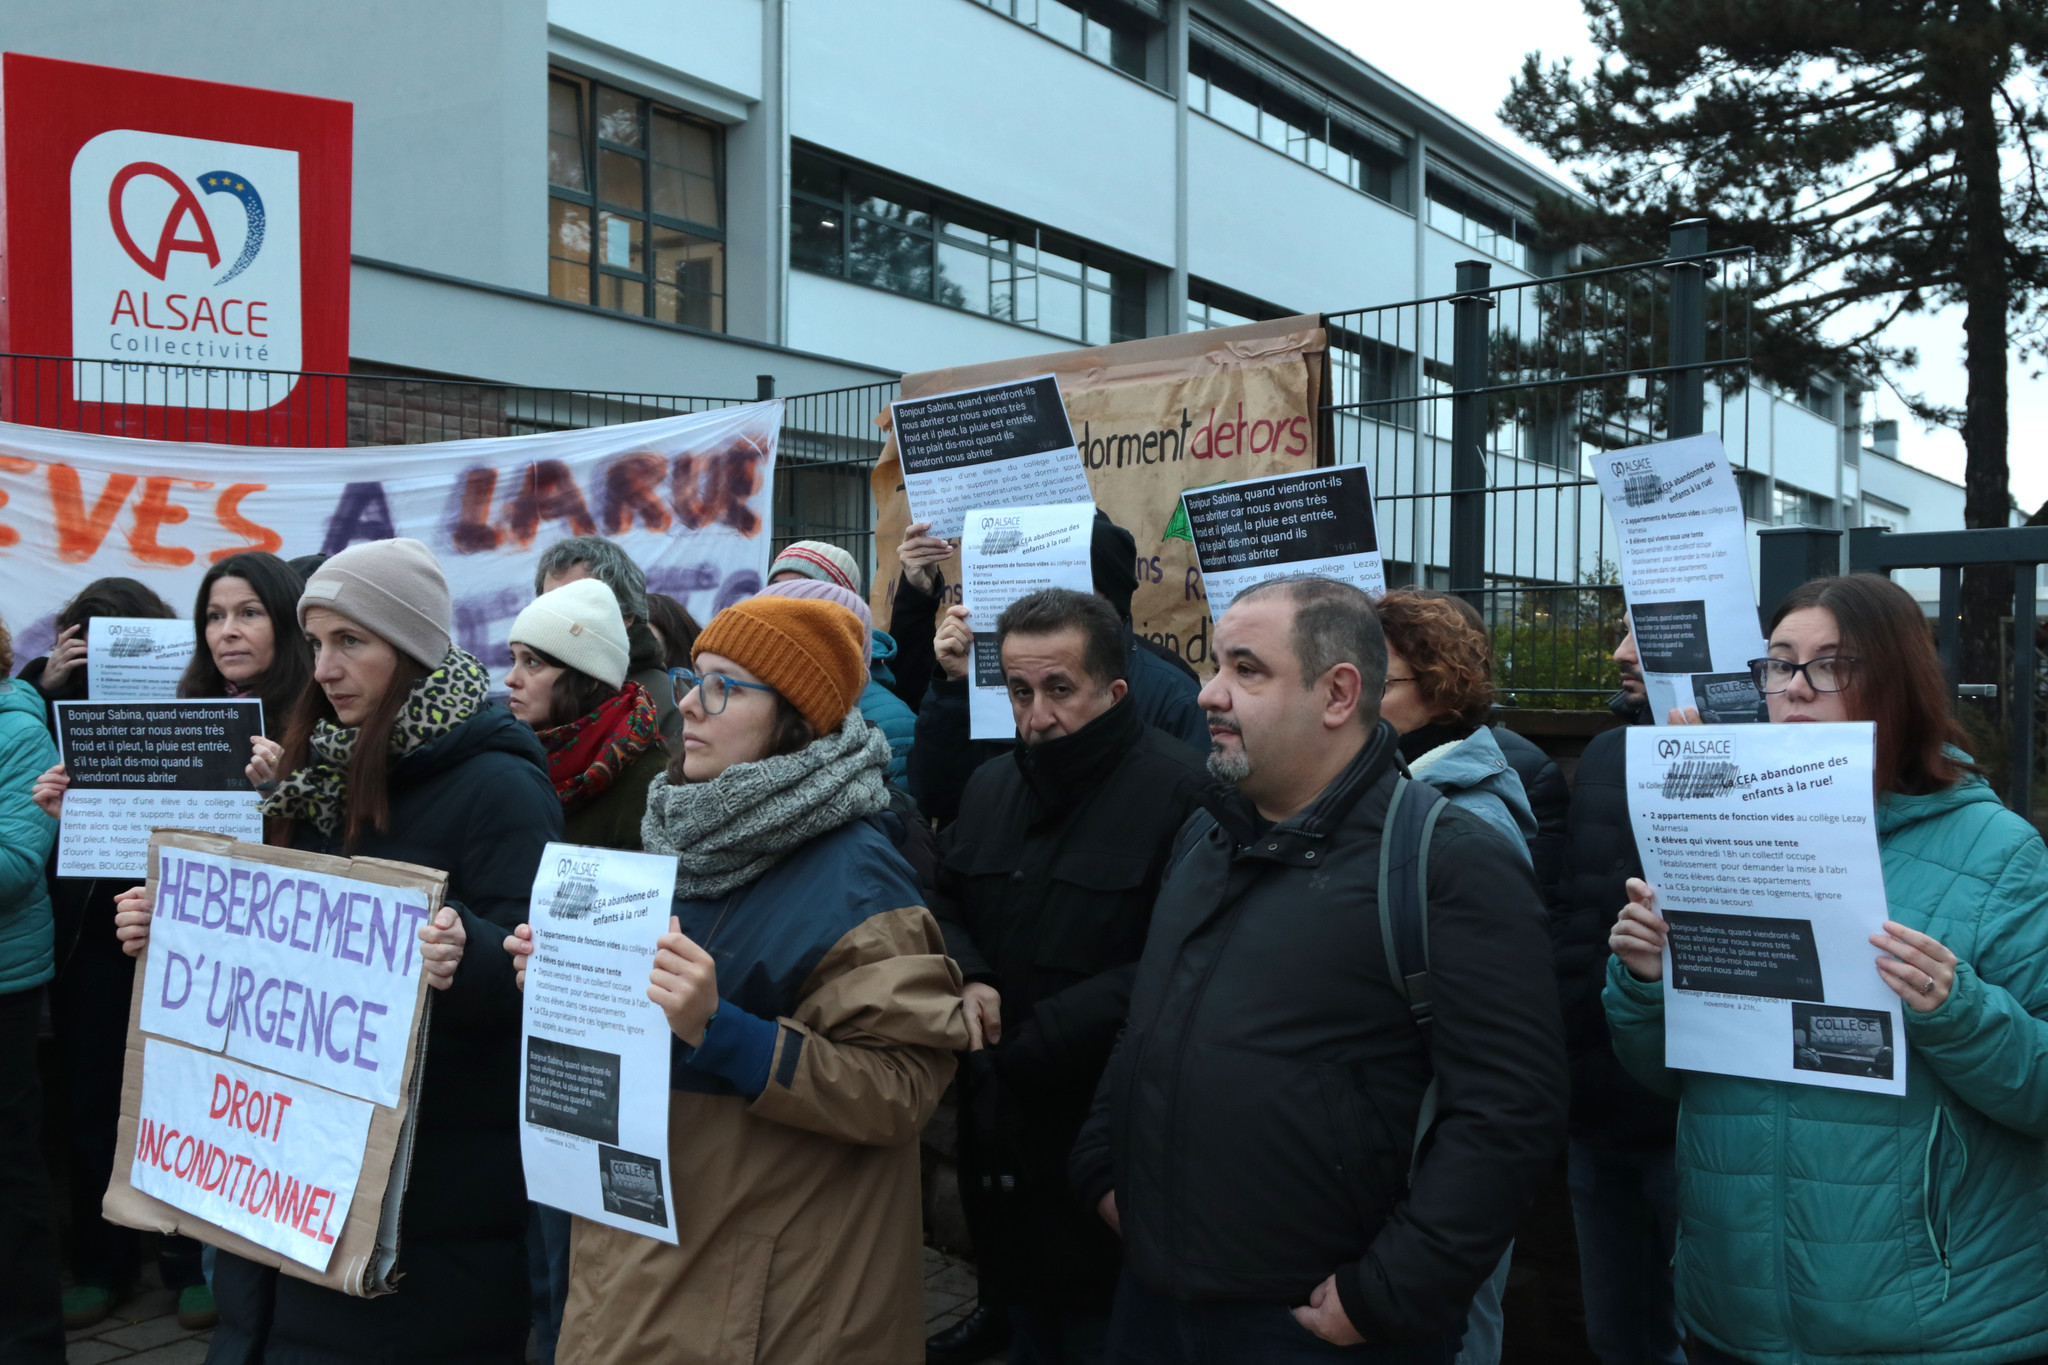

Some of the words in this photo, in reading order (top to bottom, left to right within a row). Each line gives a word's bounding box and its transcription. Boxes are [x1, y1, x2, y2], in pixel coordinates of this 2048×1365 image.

[110, 289, 268, 337] ALSACE
[110, 333, 268, 361] Collectivité
[900, 408, 925, 417] Bonjour
[927, 403, 956, 413] Sabina,
[957, 396, 982, 409] quand
[984, 387, 1035, 403] viendront-ils
[902, 421, 919, 430] nous
[920, 417, 944, 427] abriter
[946, 415, 958, 423] car
[960, 411, 980, 421] nous
[982, 406, 1007, 417] avons
[1009, 402, 1026, 412] très
[904, 432, 920, 442] froid
[922, 432, 929, 440] et
[930, 430, 936, 438] il
[937, 425, 960, 440] pleut,
[959, 425, 967, 434] la
[969, 422, 989, 434] pluie
[991, 419, 1004, 429] est
[1006, 414, 1036, 426] entrée,
[1079, 408, 1192, 469] dorment
[1192, 402, 1307, 460] dehors
[907, 446, 918, 455] s'il
[917, 442, 925, 453] te
[926, 442, 944, 455] plaît
[945, 437, 974, 449] dis-moi
[976, 432, 1002, 446] quand
[1004, 431, 1014, 440] ils
[910, 456, 943, 467] viendront
[945, 454, 965, 462] nous
[967, 449, 992, 459] abriter
[1188, 498, 1210, 510] Bonjour
[1212, 493, 1242, 505] Sabina,
[1245, 486, 1275, 501] quand
[1278, 476, 1342, 494] viendront-ils
[1193, 515, 1206, 523] nous
[1206, 510, 1229, 521] abriter
[1231, 508, 1244, 517] car
[1247, 504, 1271, 514] nous
[1274, 499, 1304, 510] avons
[1306, 494, 1327, 506] très
[1196, 526, 1208, 537] froid
[1208, 526, 1214, 536] et
[1215, 524, 1220, 534] il
[1221, 522, 1242, 536] pleut,
[1244, 520, 1252, 530] la
[1255, 517, 1279, 531] pluie
[1282, 514, 1298, 525] est
[1300, 509, 1336, 522] entrée,
[1206, 542, 1212, 551] te
[1211, 539, 1226, 552] plaît
[1228, 534, 1258, 548] dis-moi
[1261, 529, 1293, 545] quand
[1296, 528, 1307, 538] ils
[1203, 555, 1227, 566] viendront
[1228, 553, 1246, 563] nous
[1248, 548, 1279, 560] abriter
[68, 710, 105, 723] Bonjour
[108, 709, 144, 720] Sabina,
[146, 709, 176, 722] quand
[179, 708, 239, 719] viendront-ils
[70, 728, 94, 736] nous
[96, 725, 128, 735] abriter
[130, 727, 146, 735] car
[148, 727, 172, 735] nous
[174, 727, 202, 735] avons
[205, 724, 224, 735] très
[72, 740, 94, 751] froid
[96, 742, 106, 751] et
[108, 740, 114, 751] il
[117, 740, 143, 753] pleut,
[145, 740, 154, 751] la
[156, 740, 179, 753] pluie
[181, 742, 195, 751] est
[198, 740, 231, 752] entrée,
[1683, 740, 1730, 754] ALSACE
[74, 756, 86, 766] s'il
[88, 757, 98, 766] te
[101, 756, 122, 768] plaît
[124, 756, 159, 766] dis-moi
[161, 756, 190, 769] quand
[193, 756, 203, 767] ils
[1735, 773, 1758, 786] CEA
[1761, 762, 1824, 781] abandonne
[1828, 757, 1848, 767] des
[76, 771, 120, 782] viendront
[122, 774, 145, 782] nous
[147, 772, 177, 783] abriter
[1742, 787, 1784, 801] enfants
[1787, 783, 1794, 793] à
[1796, 781, 1807, 791] la
[1810, 775, 1833, 788] rue!
[66, 794, 102, 806] Message
[109, 798, 126, 806] reçu
[133, 797, 154, 805] d'une
[161, 797, 181, 805] élève
[187, 798, 197, 806] du
[205, 798, 235, 808] collège
[65, 809, 104, 818] Marnesia,
[178, 811, 195, 820] plus
[246, 811, 262, 820] sous
[1657, 813, 1717, 821] appartements
[1732, 812, 1768, 821] fonction
[1771, 813, 1794, 821] vides
[1809, 814, 1839, 824] collège
[1842, 815, 1866, 824] Lezay
[1652, 824, 1688, 832] Marnesia
[1661, 836, 1687, 844] élèves
[1689, 838, 1703, 846] qui
[1657, 848, 1684, 857] Depuis
[1722, 850, 1737, 858] 18h
[1752, 851, 1783, 859] collectif
[1786, 853, 1816, 862] occupe
[571, 861, 600, 877] ALSACE
[1660, 859, 1717, 869] l'établissement
[1742, 863, 1784, 872] demander
[1819, 865, 1824, 873] à
[1826, 866, 1847, 874] l'abri
[592, 899, 606, 911] CEA
[608, 892, 645, 906] abandonne
[647, 889, 659, 899] des
[155, 857, 429, 977] HEBERGEMENT
[593, 914, 618, 926] enfants
[620, 911, 624, 921] à
[626, 910, 632, 919] la
[634, 907, 648, 918] rue!
[160, 950, 388, 1072] D'URGENCE
[1815, 1018, 1877, 1032] COLLEGE
[209, 1073, 292, 1142] DROIT
[137, 1118, 336, 1244] INCONDITIONNEL
